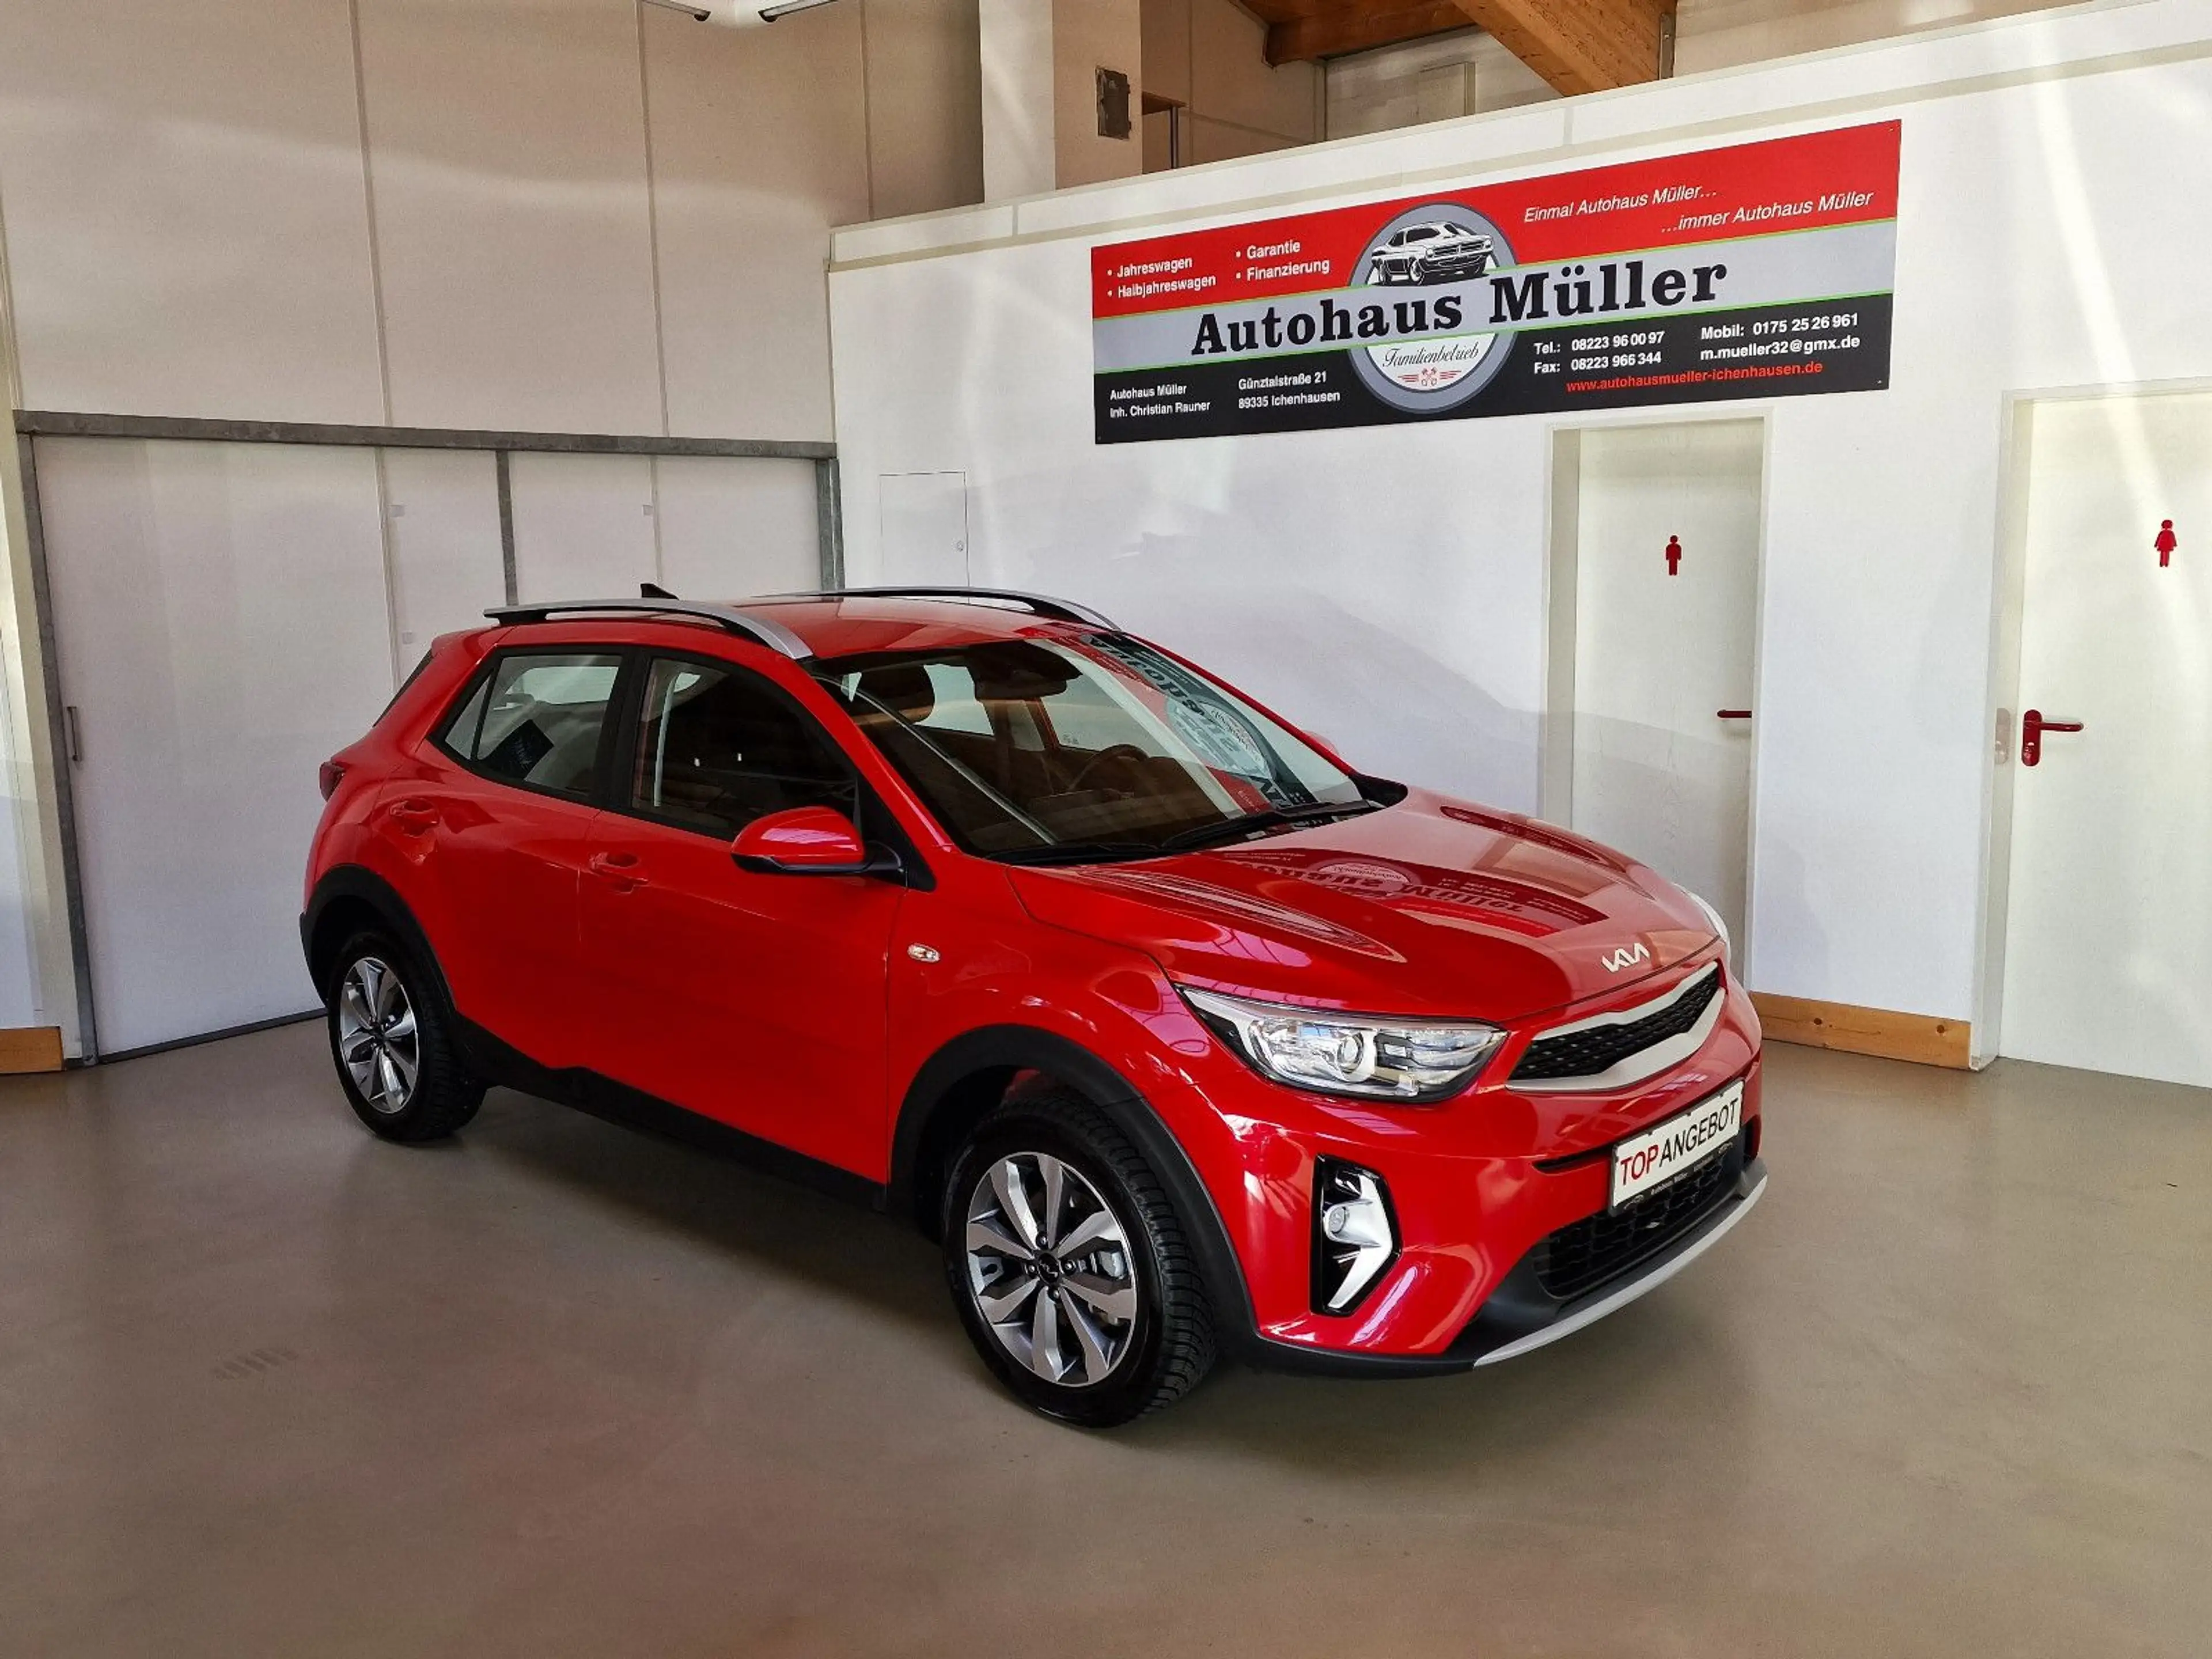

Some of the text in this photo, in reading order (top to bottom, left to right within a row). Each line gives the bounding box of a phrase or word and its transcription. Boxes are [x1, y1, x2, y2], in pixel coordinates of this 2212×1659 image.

[1524, 203, 1574, 223] Einmal
[1576, 194, 1648, 216] Autohaus
[1733, 199, 1813, 224] Autohaus
[1819, 191, 1873, 211] Müller
[1247, 239, 1301, 259] Garantie
[1116, 256, 1193, 278] Jahreswagen
[1247, 260, 1331, 281] Finanzierung
[1118, 275, 1217, 298] Halbjahreswagen
[1191, 260, 1728, 355] Autohaus Müller
[1700, 323, 1744, 340] Mobil:
[1752, 320, 1787, 335] 0175
[1382, 342, 1479, 368] Familienbetrieb
[1534, 342, 1560, 355] Tel.:
[1571, 335, 1609, 351] 08223
[1700, 335, 1861, 361] m.mueller32@gmx.de
[1534, 361, 1560, 374] Fax:
[1571, 356, 1609, 372] 08223
[1566, 360, 1823, 392] www.autohausmueller-ichenhausen.de
[1238, 371, 1327, 390] Günztalstraße 21
[1110, 384, 1187, 401] Autohaus Müller
[1238, 391, 1340, 409] 89335 Ichenhausen
[1110, 400, 1211, 419] Inh. Christian Rauner
[1601, 942, 1651, 973] KIA
[1620, 1143, 1659, 1186] TOP
[1658, 1097, 1739, 1169] ANGEBOT
